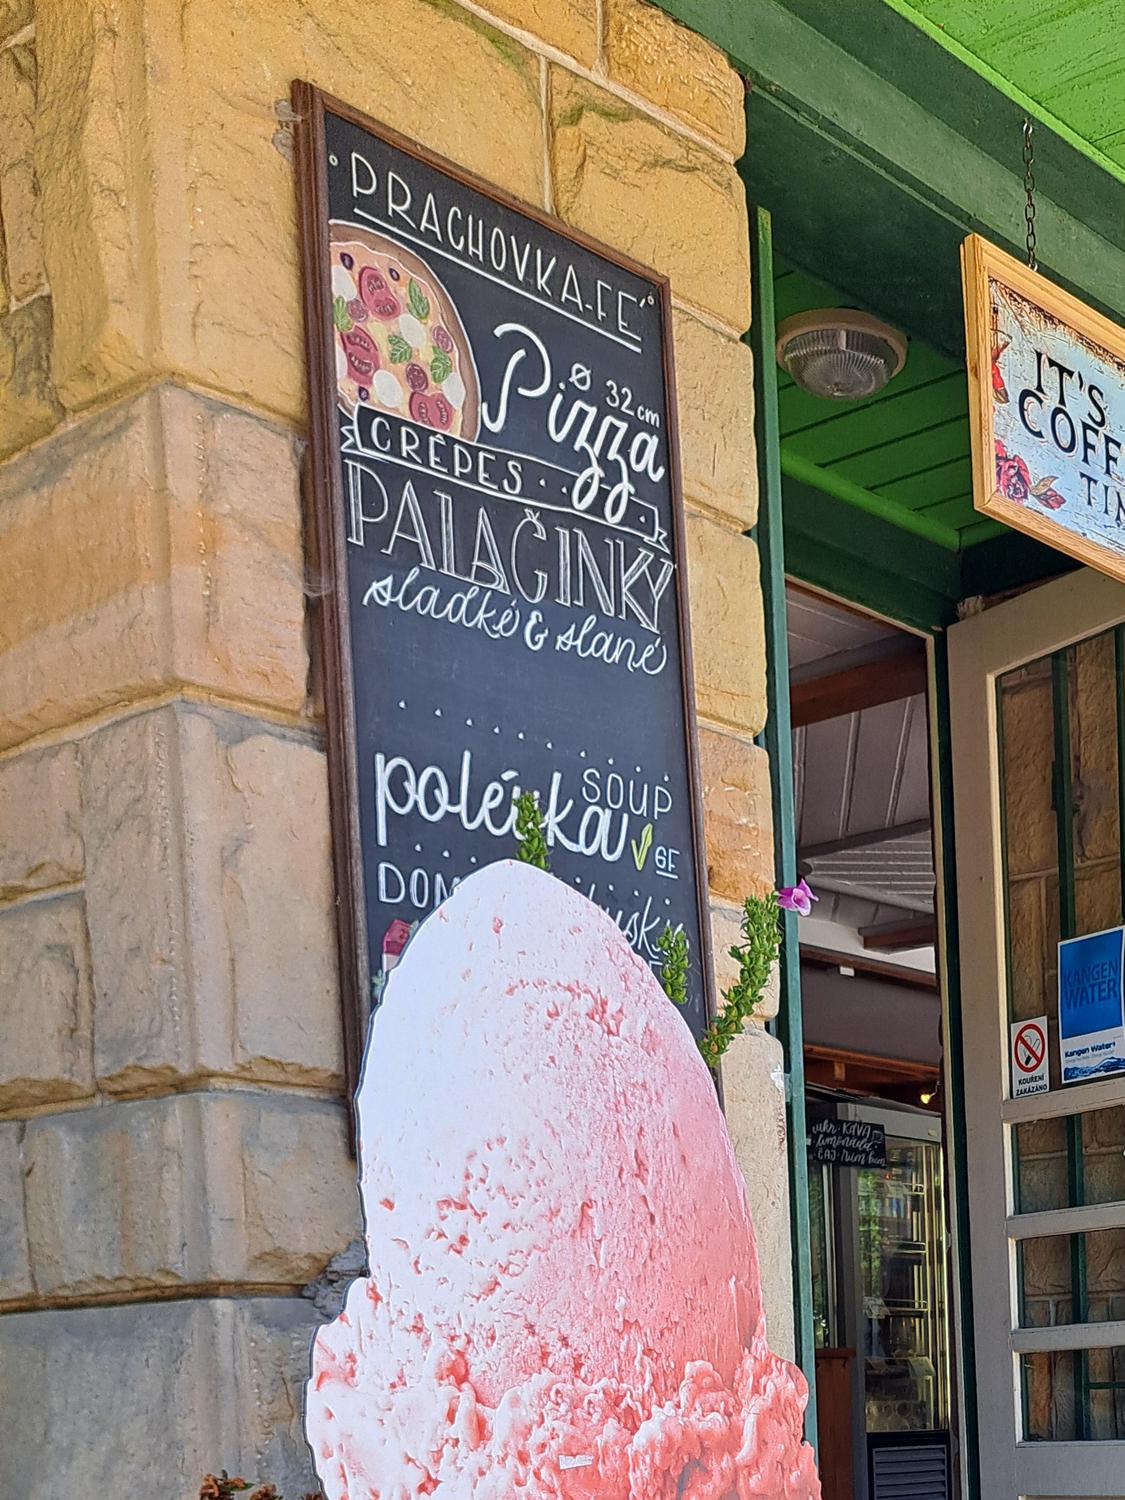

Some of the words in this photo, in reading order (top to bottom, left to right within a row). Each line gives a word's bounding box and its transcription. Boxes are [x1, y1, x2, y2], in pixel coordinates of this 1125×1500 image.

[482, 323, 665, 524] Pizza
[1035, 349, 1106, 429] IT'S
[372, 417, 523, 495] CRÊPES
[347, 459, 674, 634] PALAČINKY
[363, 566, 520, 638] sladké
[525, 611, 549, 651] &
[557, 615, 667, 675] slané
[1063, 959, 1118, 987] KANGEN
[1064, 980, 1118, 1009] WATER
[1015, 1083, 1048, 1096] ZAKÁZÁNO
[1018, 1072, 1045, 1086] KOUŘENÍ
